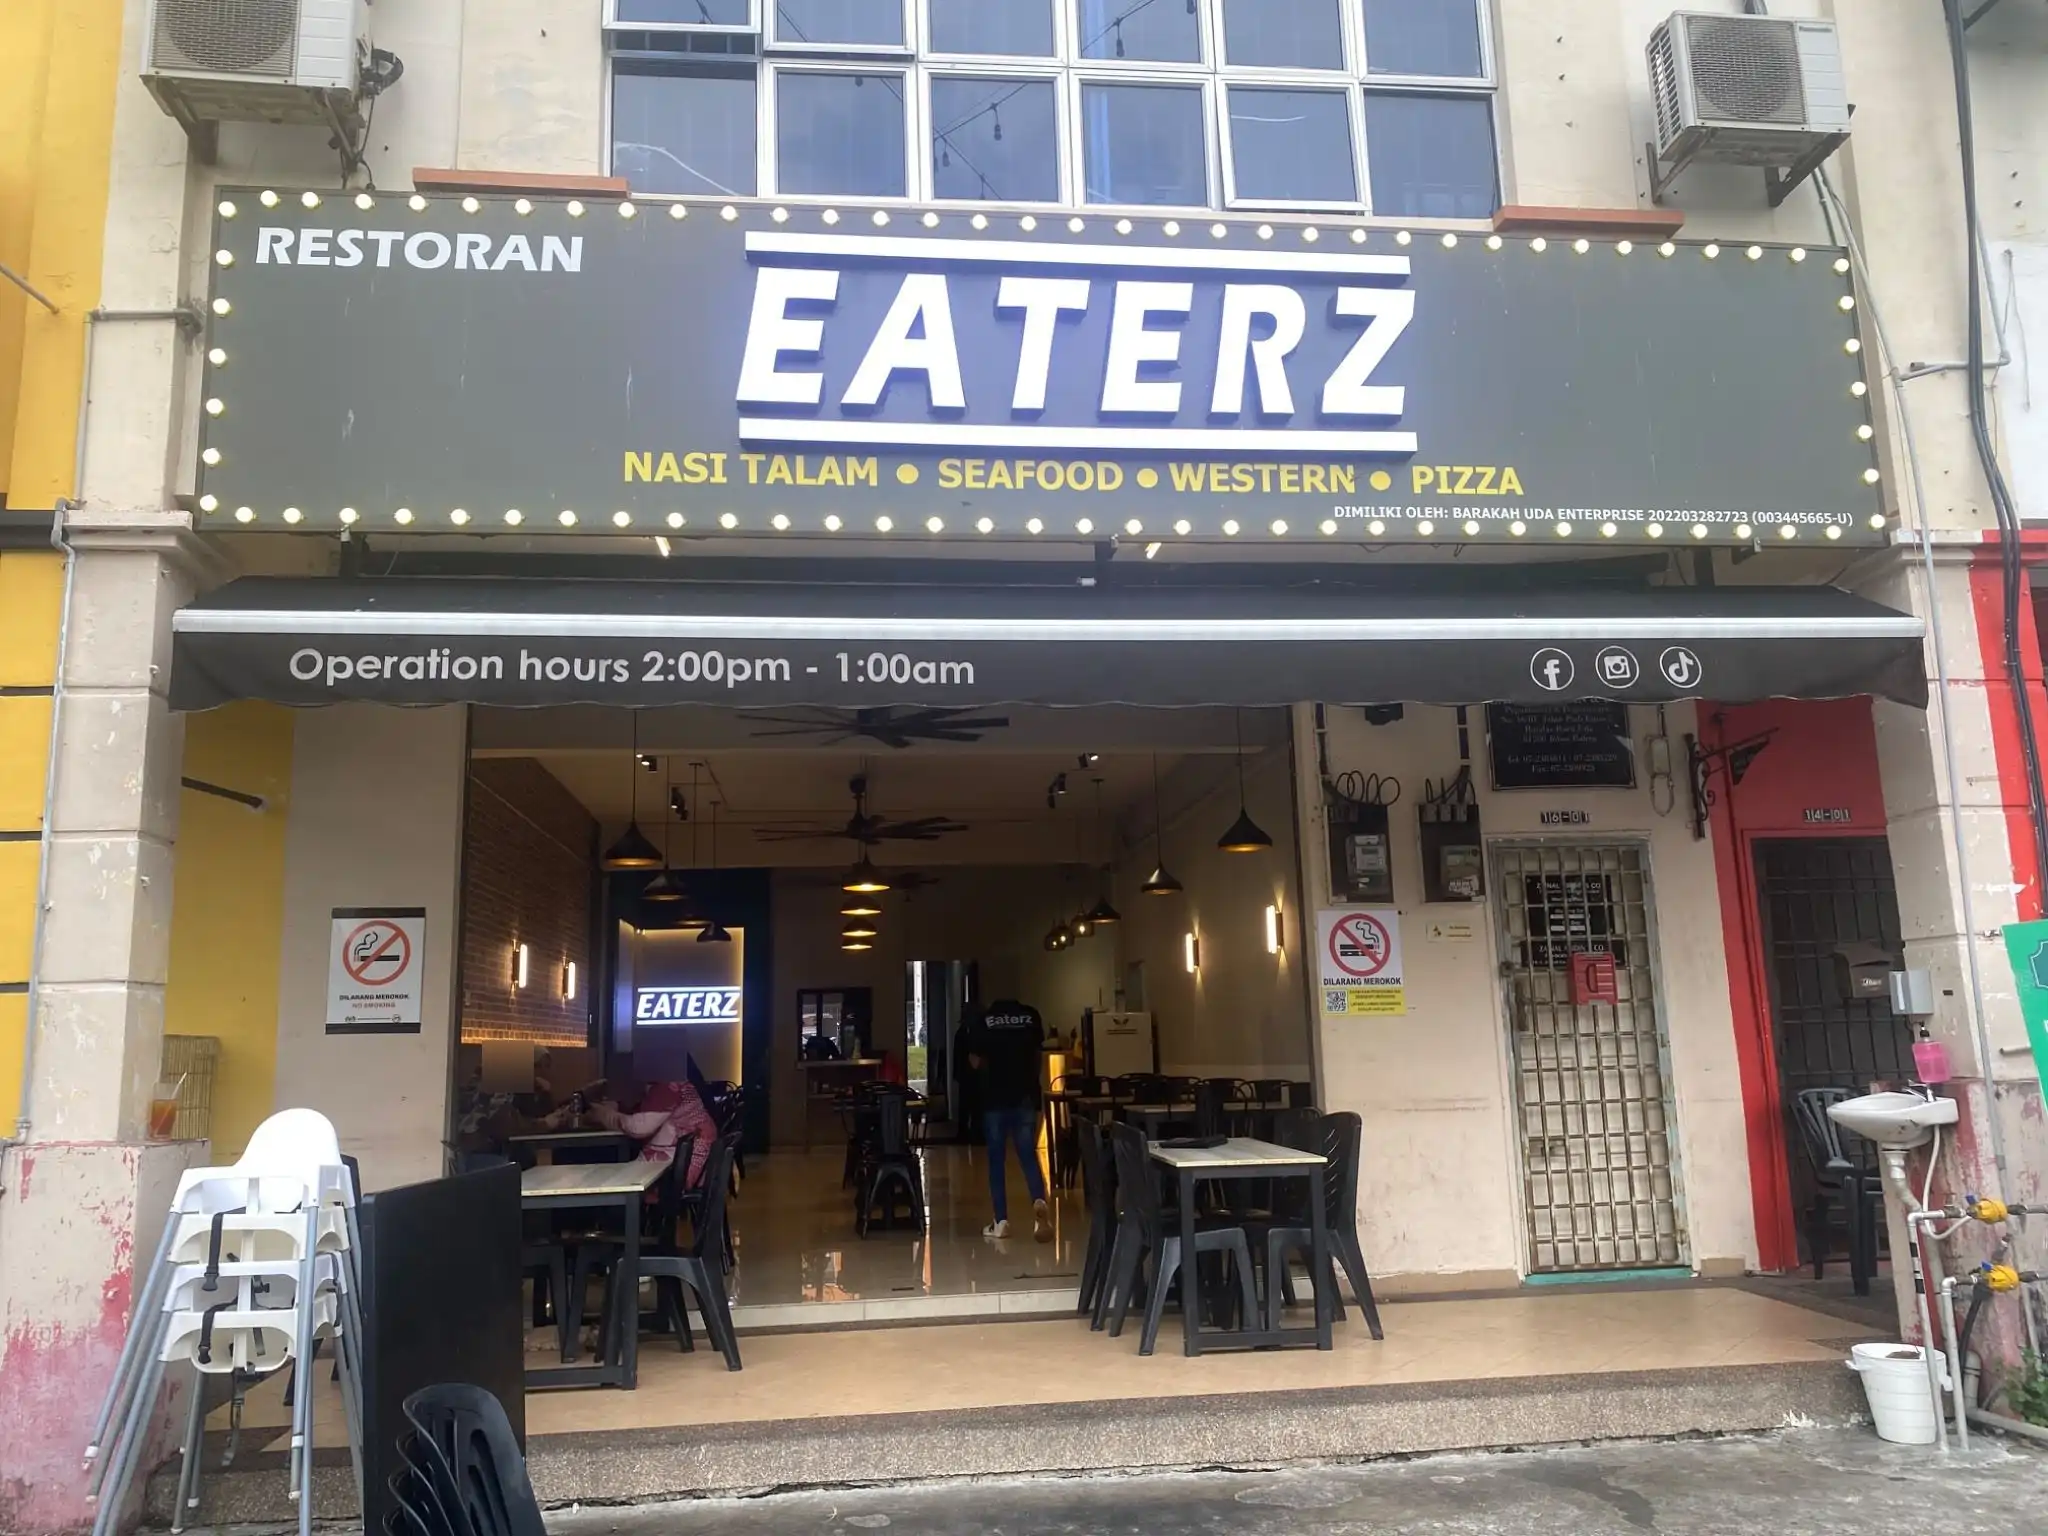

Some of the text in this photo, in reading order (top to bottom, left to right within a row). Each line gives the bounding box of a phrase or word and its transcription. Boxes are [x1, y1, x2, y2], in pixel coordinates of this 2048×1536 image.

[256, 226, 583, 272] RESTORAN
[736, 266, 1416, 416] EATERZ
[624, 451, 1524, 496] NASI TALAM SEAFOOD WESTERN PIZZA
[1334, 505, 1854, 526] DIMILIKI OLEH: BARAKAH UDA ENTERPRISE 202203282723 (003445665-U)
[289, 647, 504, 687] Operation
[519, 649, 630, 683] hours
[641, 650, 791, 689] 2:00pm
[835, 652, 975, 685] 1:00am
[1323, 976, 1402, 986] DILARANG MEROKOK
[637, 991, 740, 1019] EATERZ
[985, 1014, 1033, 1028] Eaterz
